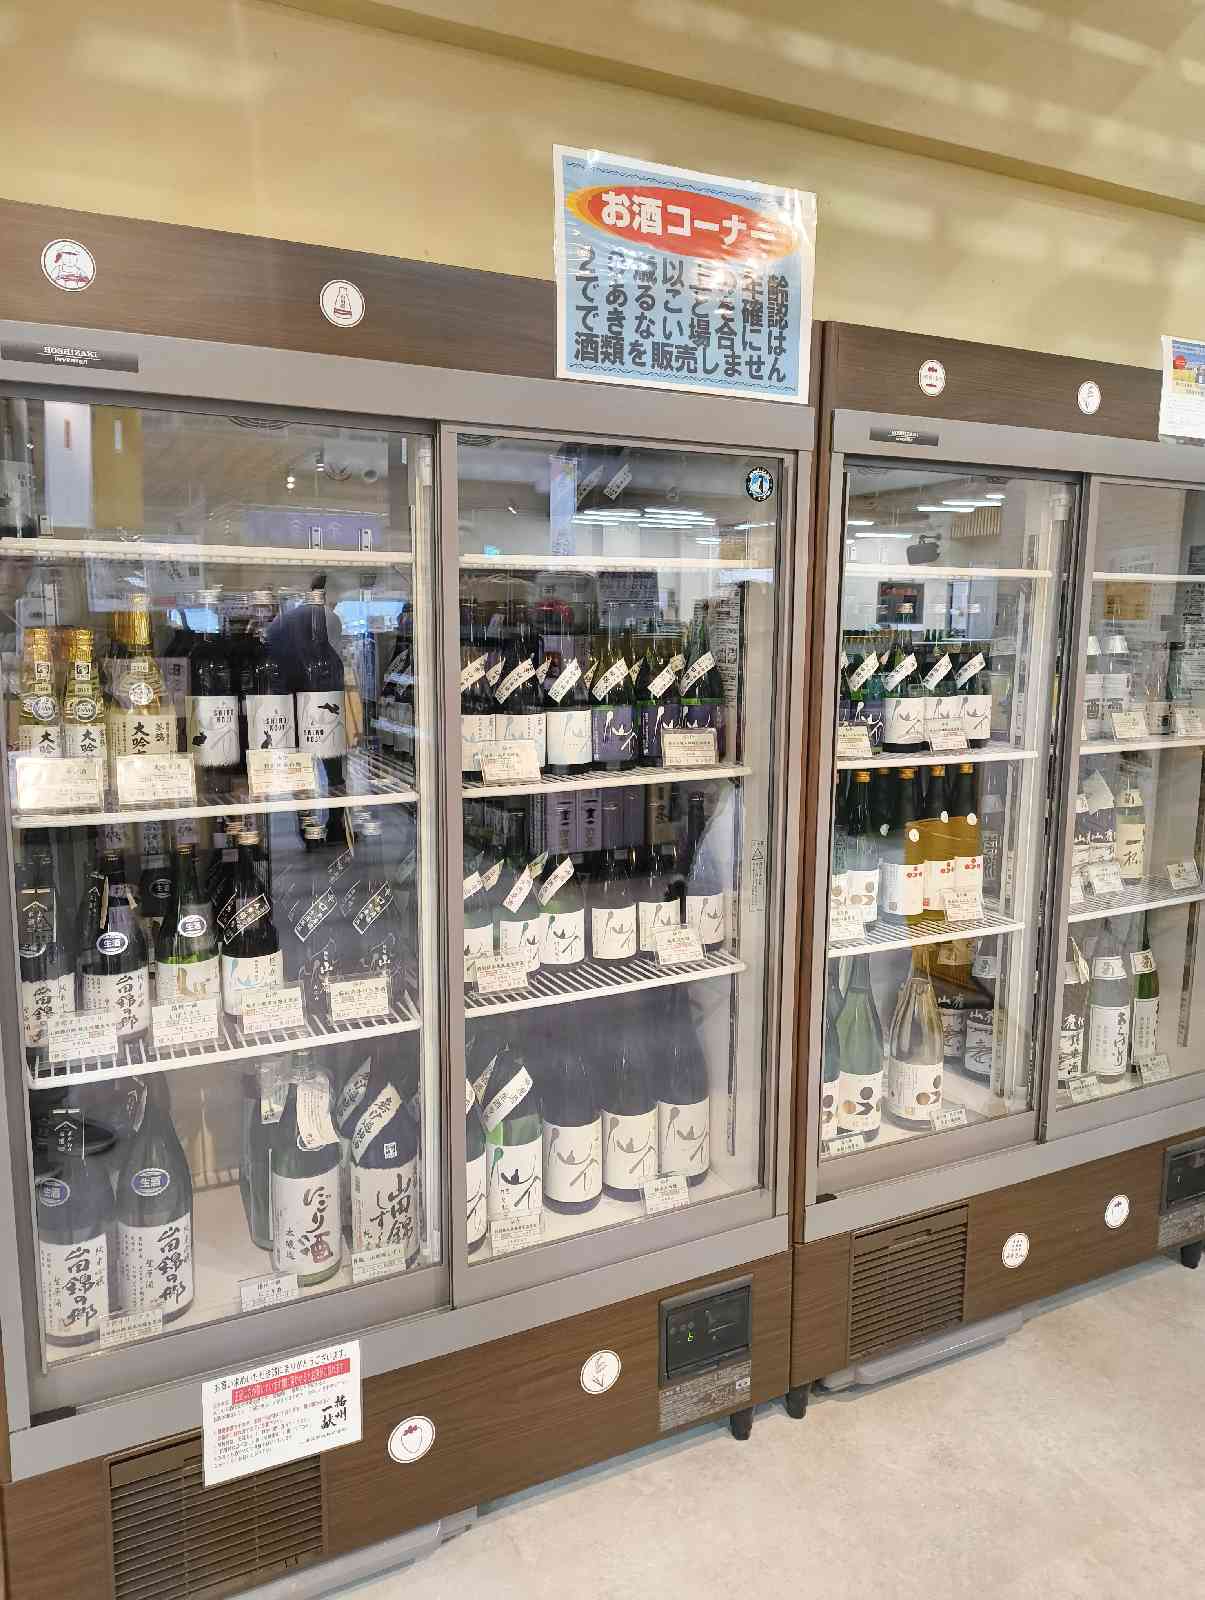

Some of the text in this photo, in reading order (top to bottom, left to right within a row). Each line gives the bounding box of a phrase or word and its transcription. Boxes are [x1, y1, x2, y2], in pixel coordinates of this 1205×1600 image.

[600, 190, 777, 246] お酒コーナー
[43, 346, 97, 359] HOSHIZAKI
[574, 330, 786, 383] 酒類を販売しません
